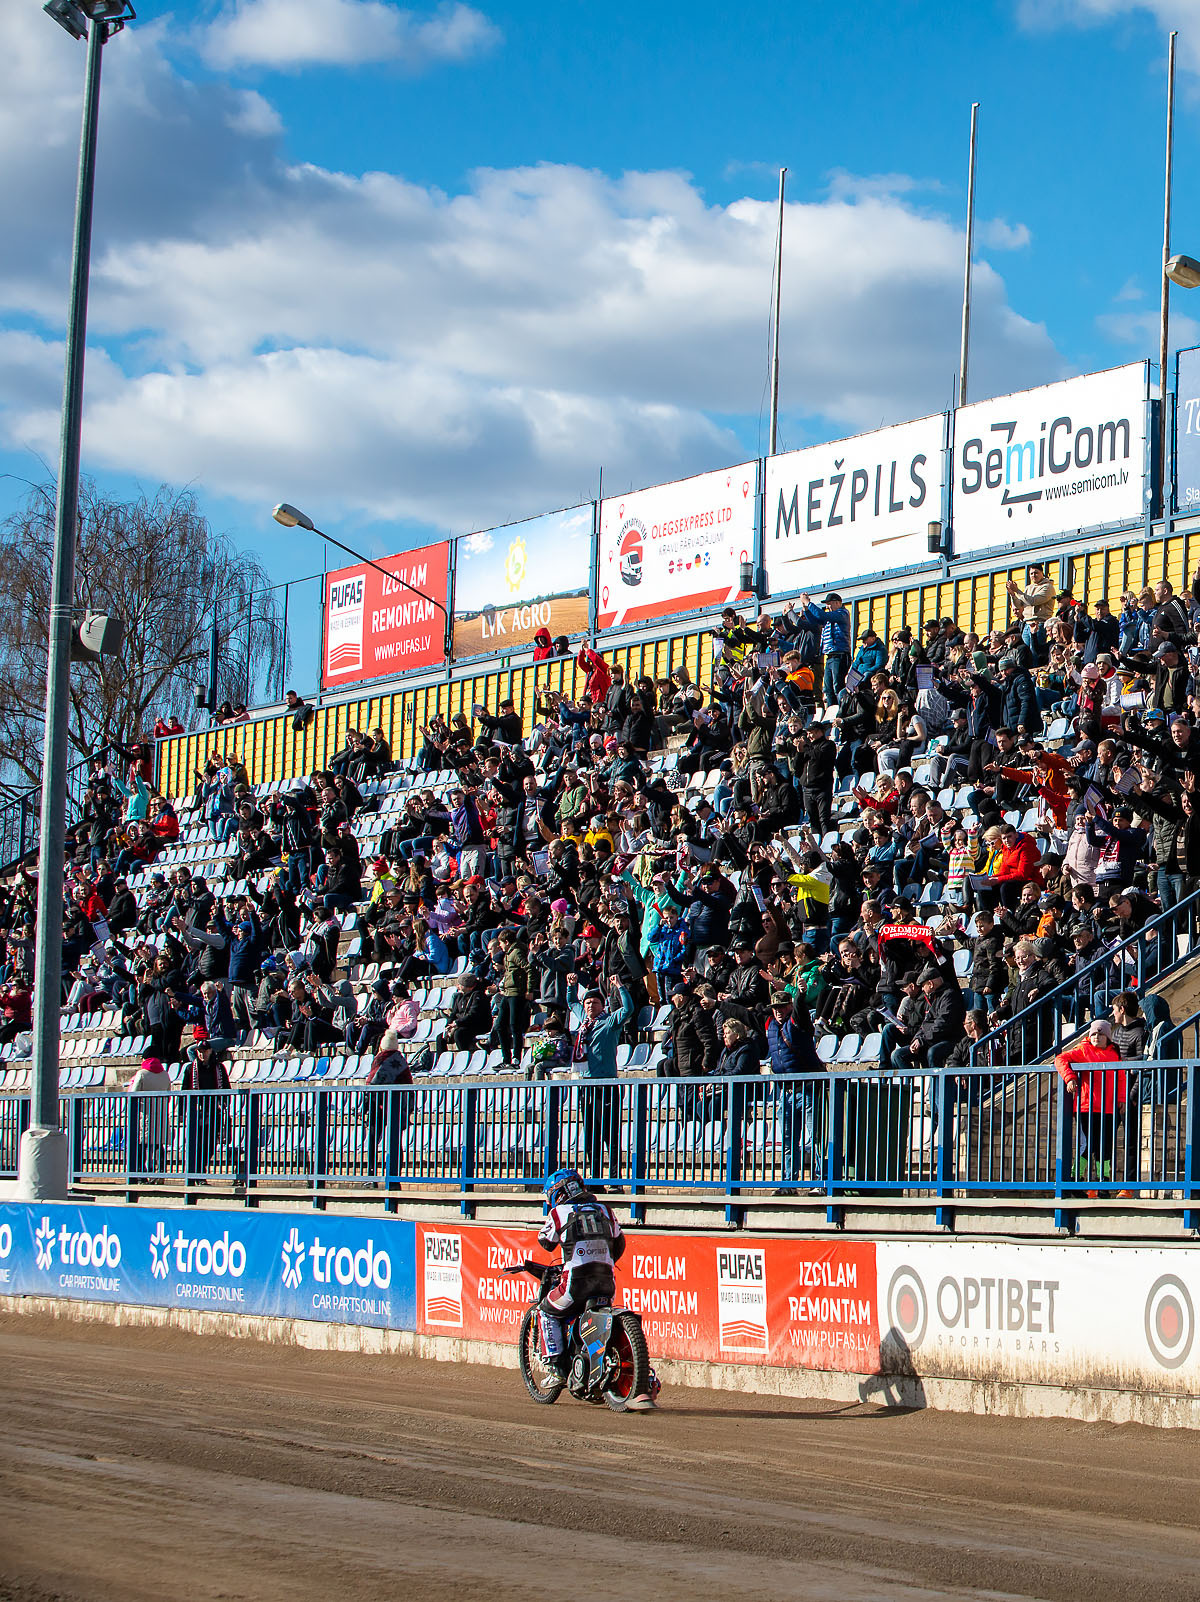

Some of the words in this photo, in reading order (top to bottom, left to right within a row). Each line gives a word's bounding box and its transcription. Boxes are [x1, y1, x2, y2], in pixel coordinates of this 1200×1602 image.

[961, 416, 1130, 495] SemiCom
[1045, 469, 1129, 501] www.semicom.lv
[776, 458, 926, 540] MEŽPILS
[652, 511, 714, 539] OLEGSEXPRESS
[718, 507, 732, 523] LTD
[382, 563, 428, 596] IZCILAM
[331, 581, 362, 610] PUFAS
[372, 597, 435, 634] REMONTAM
[481, 611, 507, 639] LVK
[512, 601, 552, 632] AGRO
[374, 635, 431, 661] WWW.PUFAS.LV
[578, 1215, 598, 1233] 11
[58, 1224, 121, 1268] trodo
[173, 1230, 246, 1278] trodo
[426, 1238, 459, 1262] PUFAS
[488, 1246, 532, 1269] IZCILAM
[308, 1237, 392, 1290] trodo
[632, 1255, 686, 1280] IZCILAM
[720, 1254, 762, 1280] PUFAS
[800, 1262, 857, 1288] IZCILAM
[60, 1274, 73, 1288] CAR
[74, 1275, 94, 1290] PARTS
[96, 1278, 120, 1292] ONLINE
[176, 1283, 192, 1298] CAR
[192, 1284, 216, 1300] PARTS
[217, 1286, 245, 1302] ONLINE
[478, 1278, 540, 1303] REMONTAM
[312, 1294, 332, 1310] CAR
[333, 1296, 360, 1312] PARTS
[360, 1298, 391, 1316] ONLINE
[622, 1288, 698, 1315] REMONTAM
[788, 1296, 871, 1326] REMONTAM
[937, 1276, 1060, 1333] OPTIBET
[789, 1329, 871, 1351] WWW.PUFAS.LV
[938, 1334, 1003, 1350] SPORTA
[1016, 1336, 1060, 1354] BĀRS
